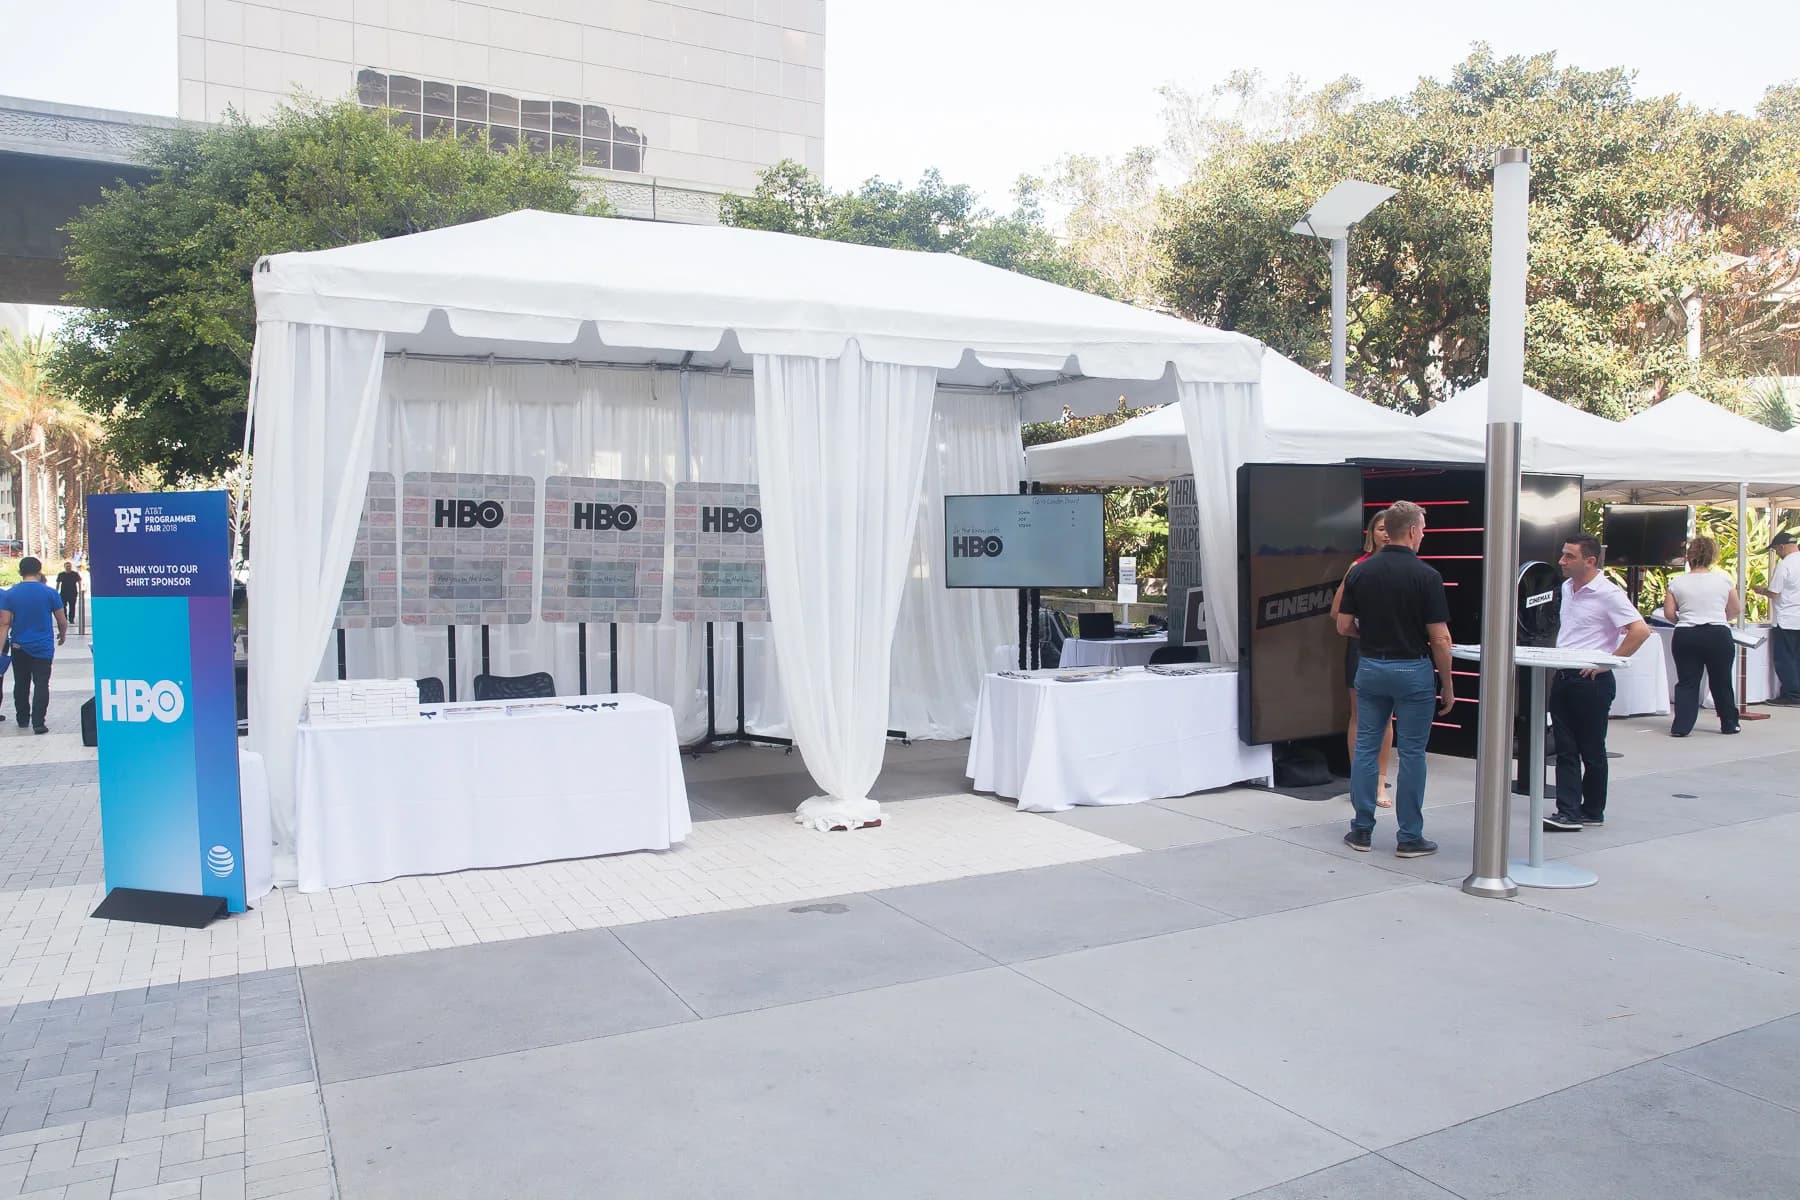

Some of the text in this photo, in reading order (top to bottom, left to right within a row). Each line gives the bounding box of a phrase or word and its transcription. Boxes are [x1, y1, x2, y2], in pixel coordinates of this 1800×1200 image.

[114, 507, 142, 533] PF
[144, 506, 163, 515] AT&T
[144, 514, 197, 524] PROGRAMMER
[434, 499, 504, 529] HBO
[573, 502, 638, 532] HBO
[702, 506, 763, 534] HBO
[145, 524, 178, 533] FAIR 2018
[953, 536, 1004, 558] HBO
[118, 564, 198, 574] THANK YOU TO OUR
[126, 577, 192, 587] SHIRT SPONSOR
[100, 678, 185, 723] HBO
